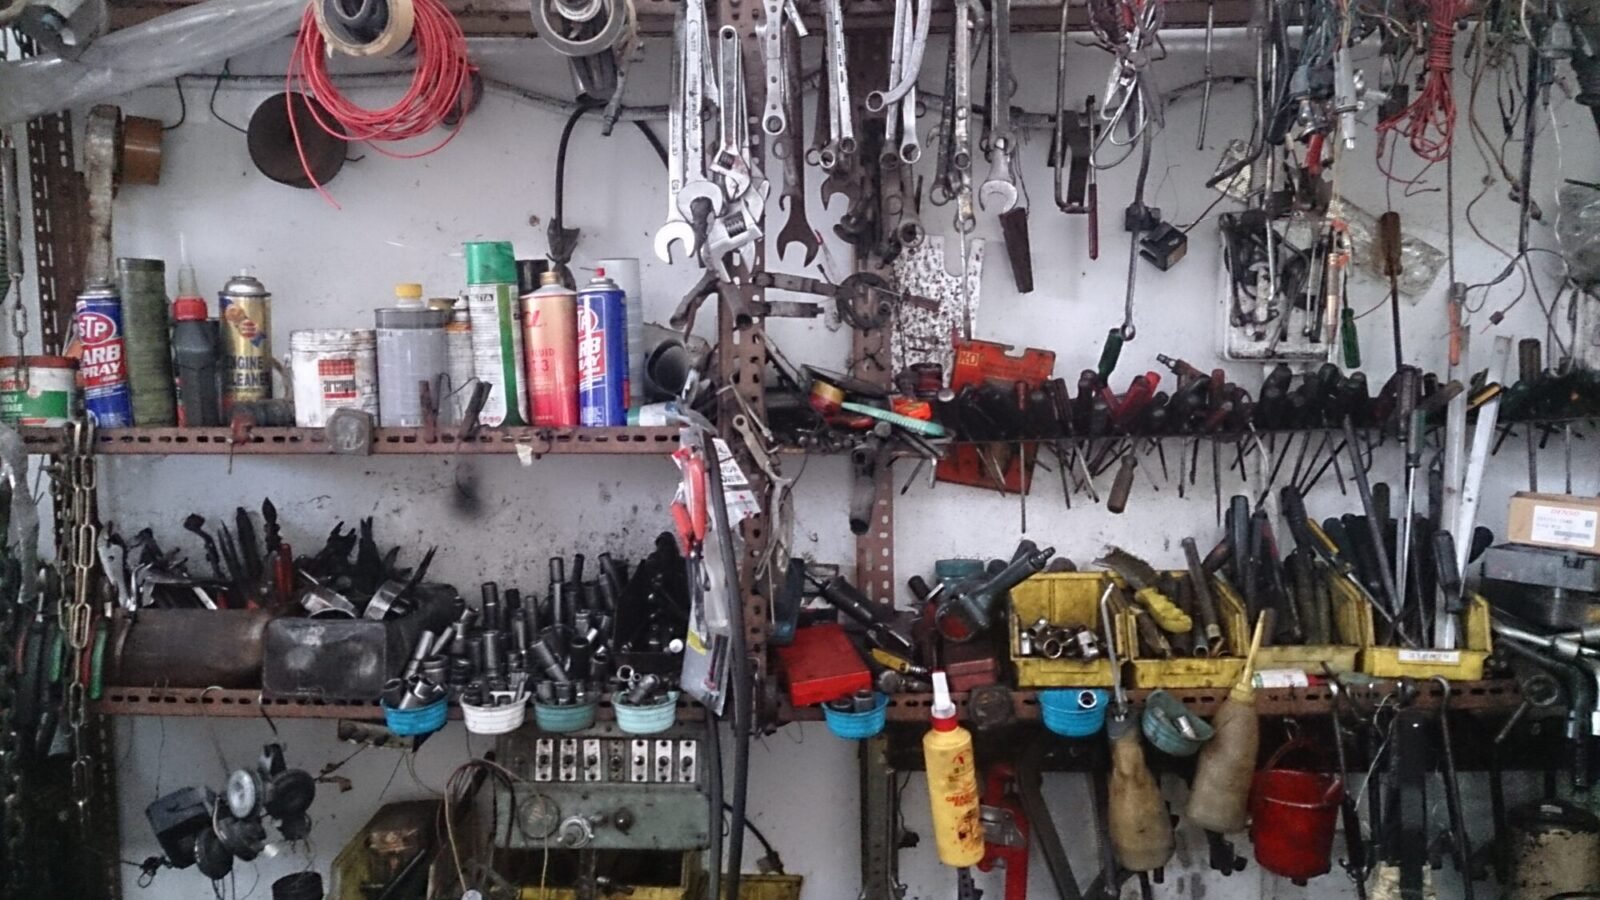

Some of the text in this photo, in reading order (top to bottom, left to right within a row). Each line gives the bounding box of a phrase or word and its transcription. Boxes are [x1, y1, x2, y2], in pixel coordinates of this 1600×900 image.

[79, 316, 108, 339] STP
[82, 344, 121, 366] ARB
[224, 355, 263, 370] ENGINE
[82, 360, 121, 379] PRAY
